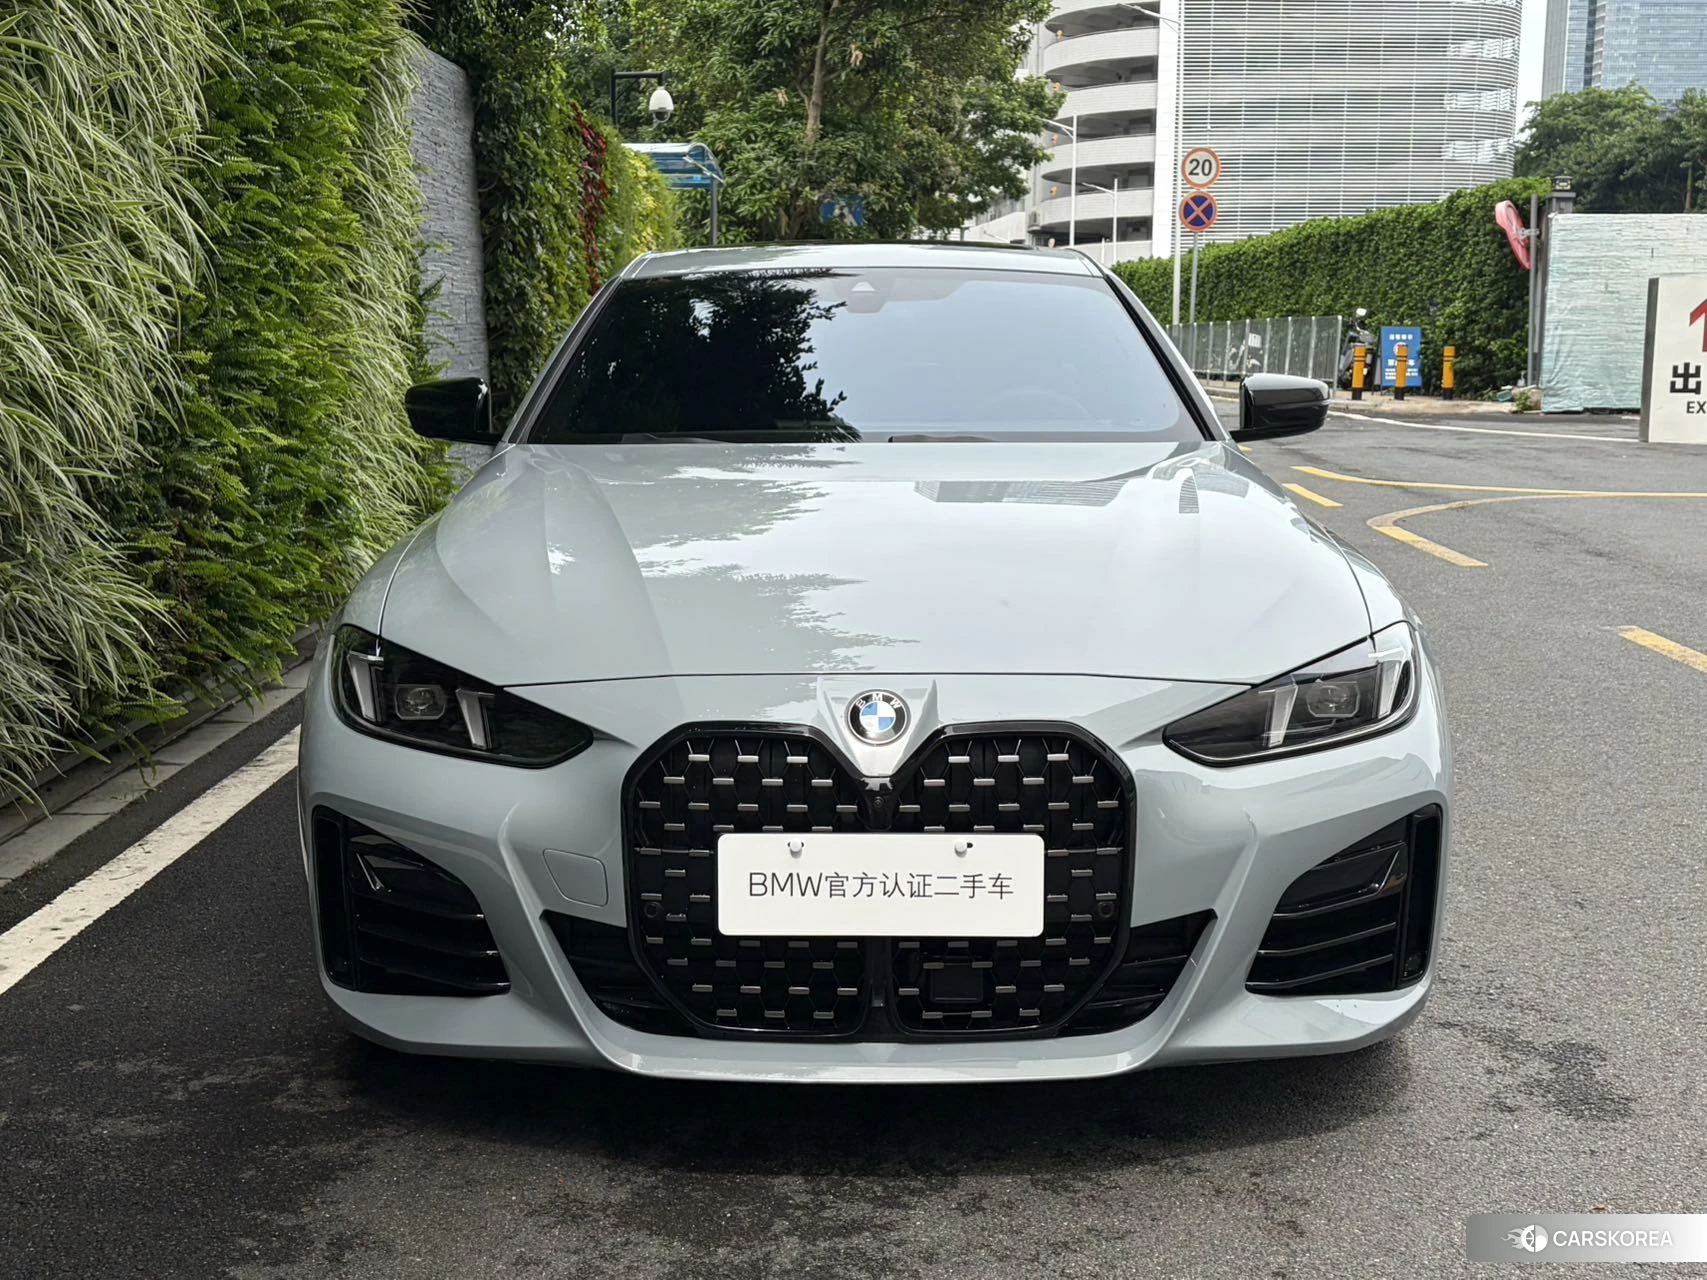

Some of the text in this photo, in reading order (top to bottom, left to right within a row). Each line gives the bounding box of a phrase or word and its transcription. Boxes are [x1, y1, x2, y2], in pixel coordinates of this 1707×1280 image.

[1188, 158, 1212, 177] 20
[1669, 362, 1702, 395] 出
[855, 693, 902, 709] BMW
[748, 871, 1014, 900] BMW官方认证二手车
